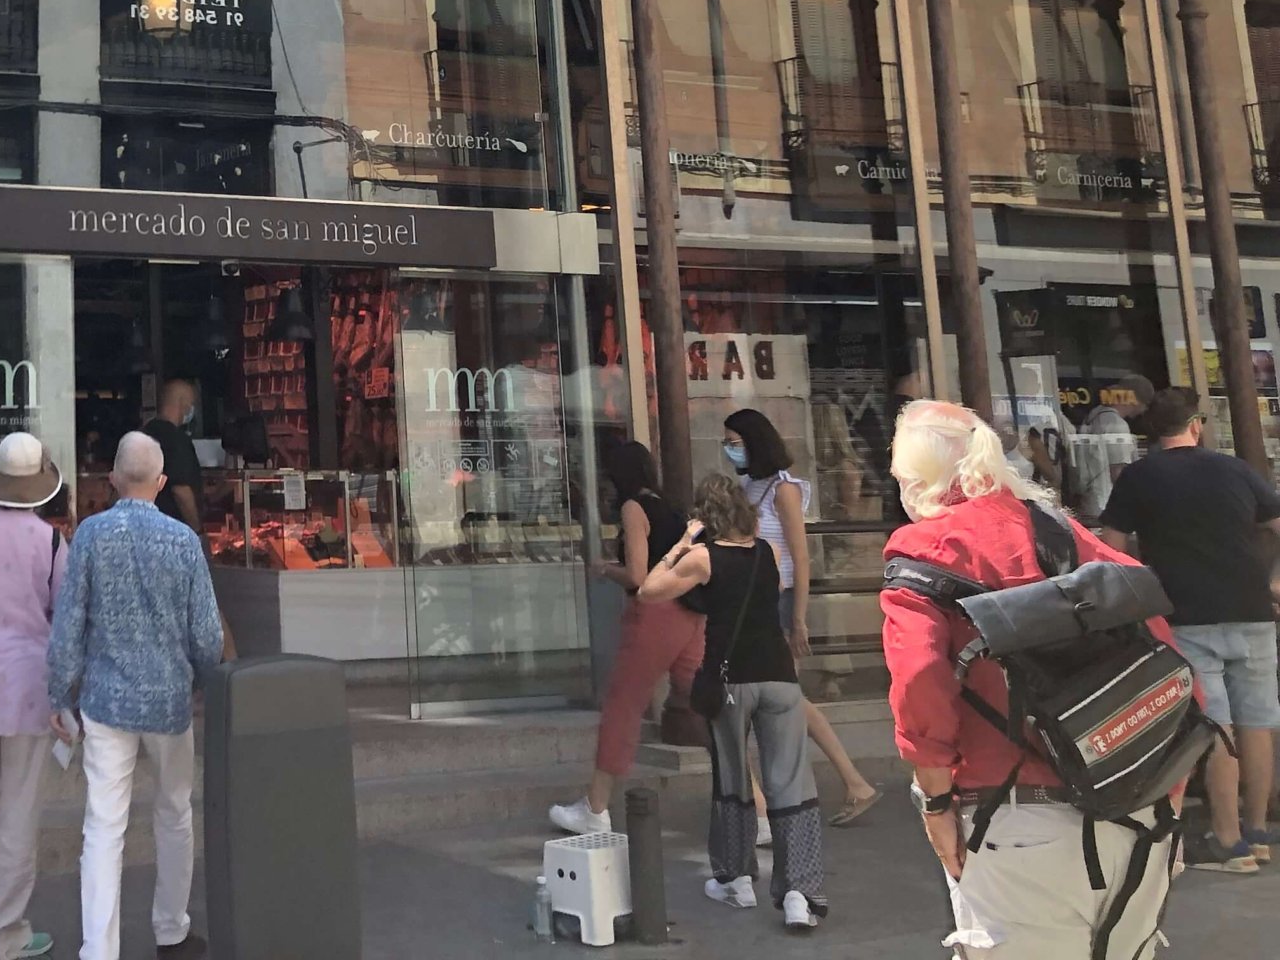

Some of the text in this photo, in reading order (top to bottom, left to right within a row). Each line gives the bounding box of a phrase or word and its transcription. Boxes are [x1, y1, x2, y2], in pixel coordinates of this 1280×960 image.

[388, 122, 501, 151] Charcutería
[857, 159, 938, 181] Carnicía
[1057, 167, 1133, 189] Carnicería
[68, 203, 418, 255] mercado de san miguel
[1105, 734, 1112, 743] I
[1127, 716, 1137, 727] GO
[1155, 694, 1168, 707] GO
